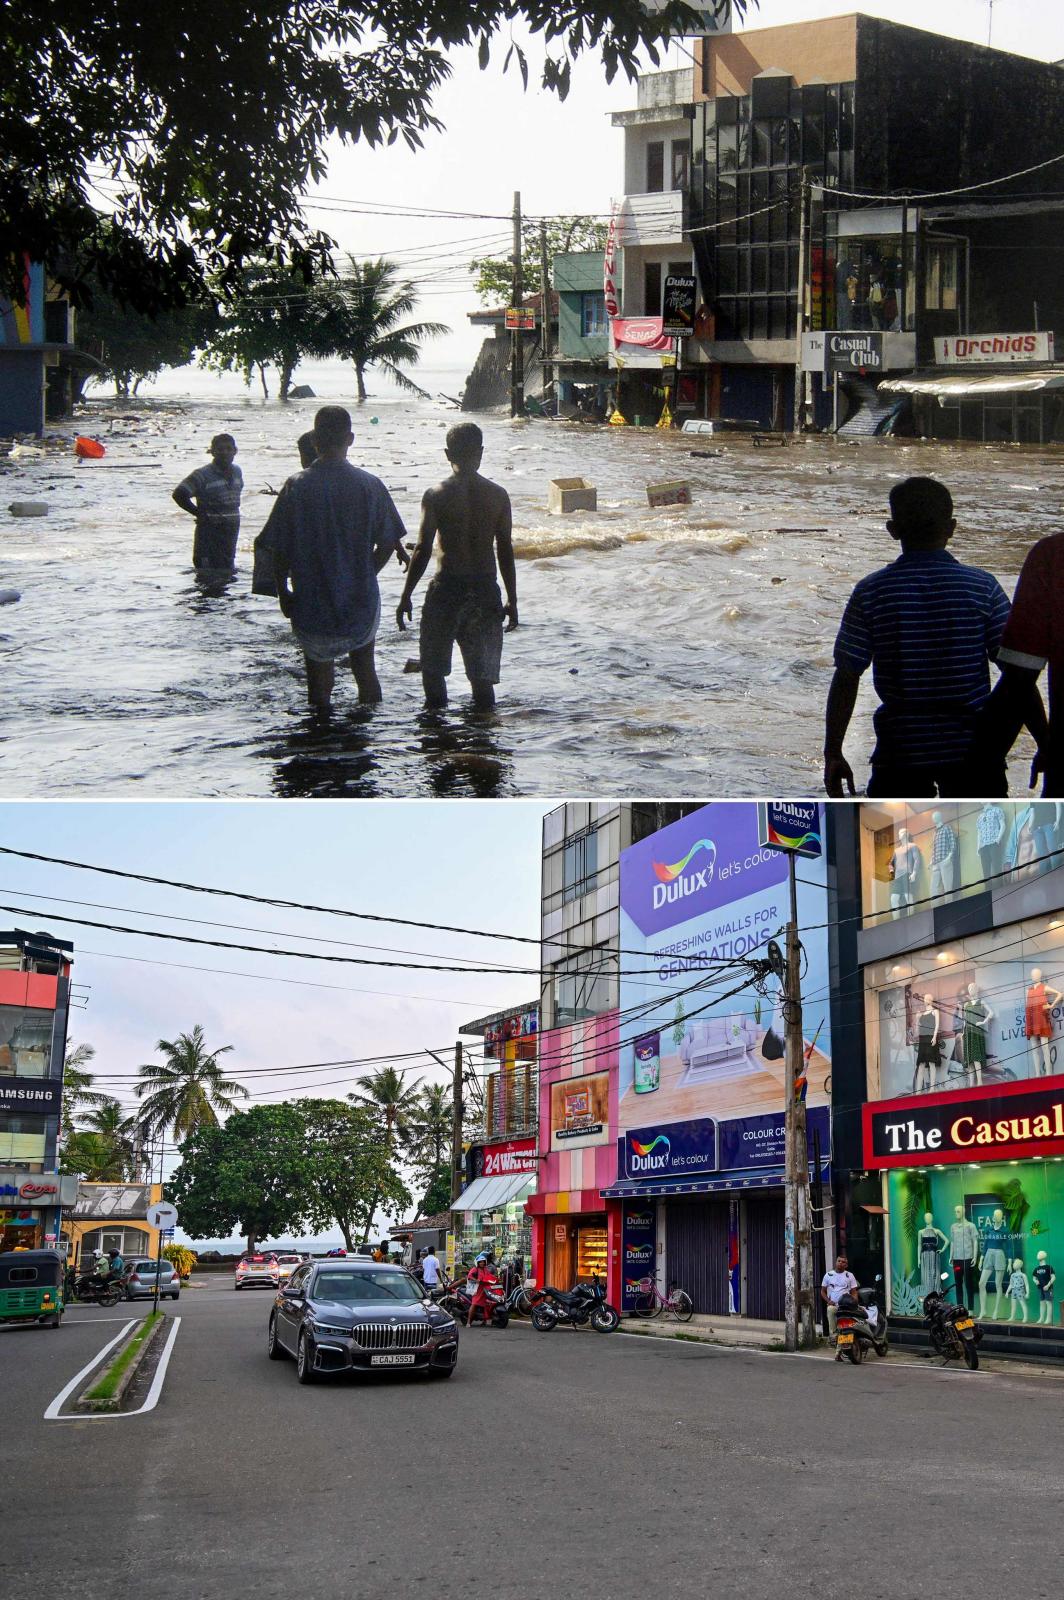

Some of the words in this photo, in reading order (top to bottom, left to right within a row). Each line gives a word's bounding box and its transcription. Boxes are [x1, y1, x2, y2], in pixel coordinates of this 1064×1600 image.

[667, 277, 695, 287] Dulux
[624, 330, 658, 340] SENAS
[810, 340, 823, 350] The
[830, 336, 871, 352] Casual
[850, 351, 880, 366] Club
[772, 802, 812, 820] Dulux
[773, 813, 788, 823] let's
[788, 818, 811, 830] colour
[653, 867, 707, 910] Dulux
[718, 862, 741, 881] let's
[653, 930, 713, 962] REFRESHING
[714, 915, 751, 938] WALLS
[754, 906, 778, 925] FOR
[658, 927, 771, 981] GENERATIONS
[743, 1128, 774, 1141] COLOUR
[775, 1127, 785, 1137] CR
[885, 1120, 942, 1152] The
[951, 1104, 1064, 1146] Casual
[485, 1153, 500, 1174] 24
[500, 1149, 536, 1171] WATCH
[631, 1154, 665, 1171] Dulux
[671, 1157, 685, 1166] let's
[686, 1154, 709, 1164] colour
[626, 1216, 650, 1225] Dulux
[626, 1250, 649, 1259] Dulux
[379, 1356, 394, 1364] CAJ
[395, 1355, 413, 1363] 5551
